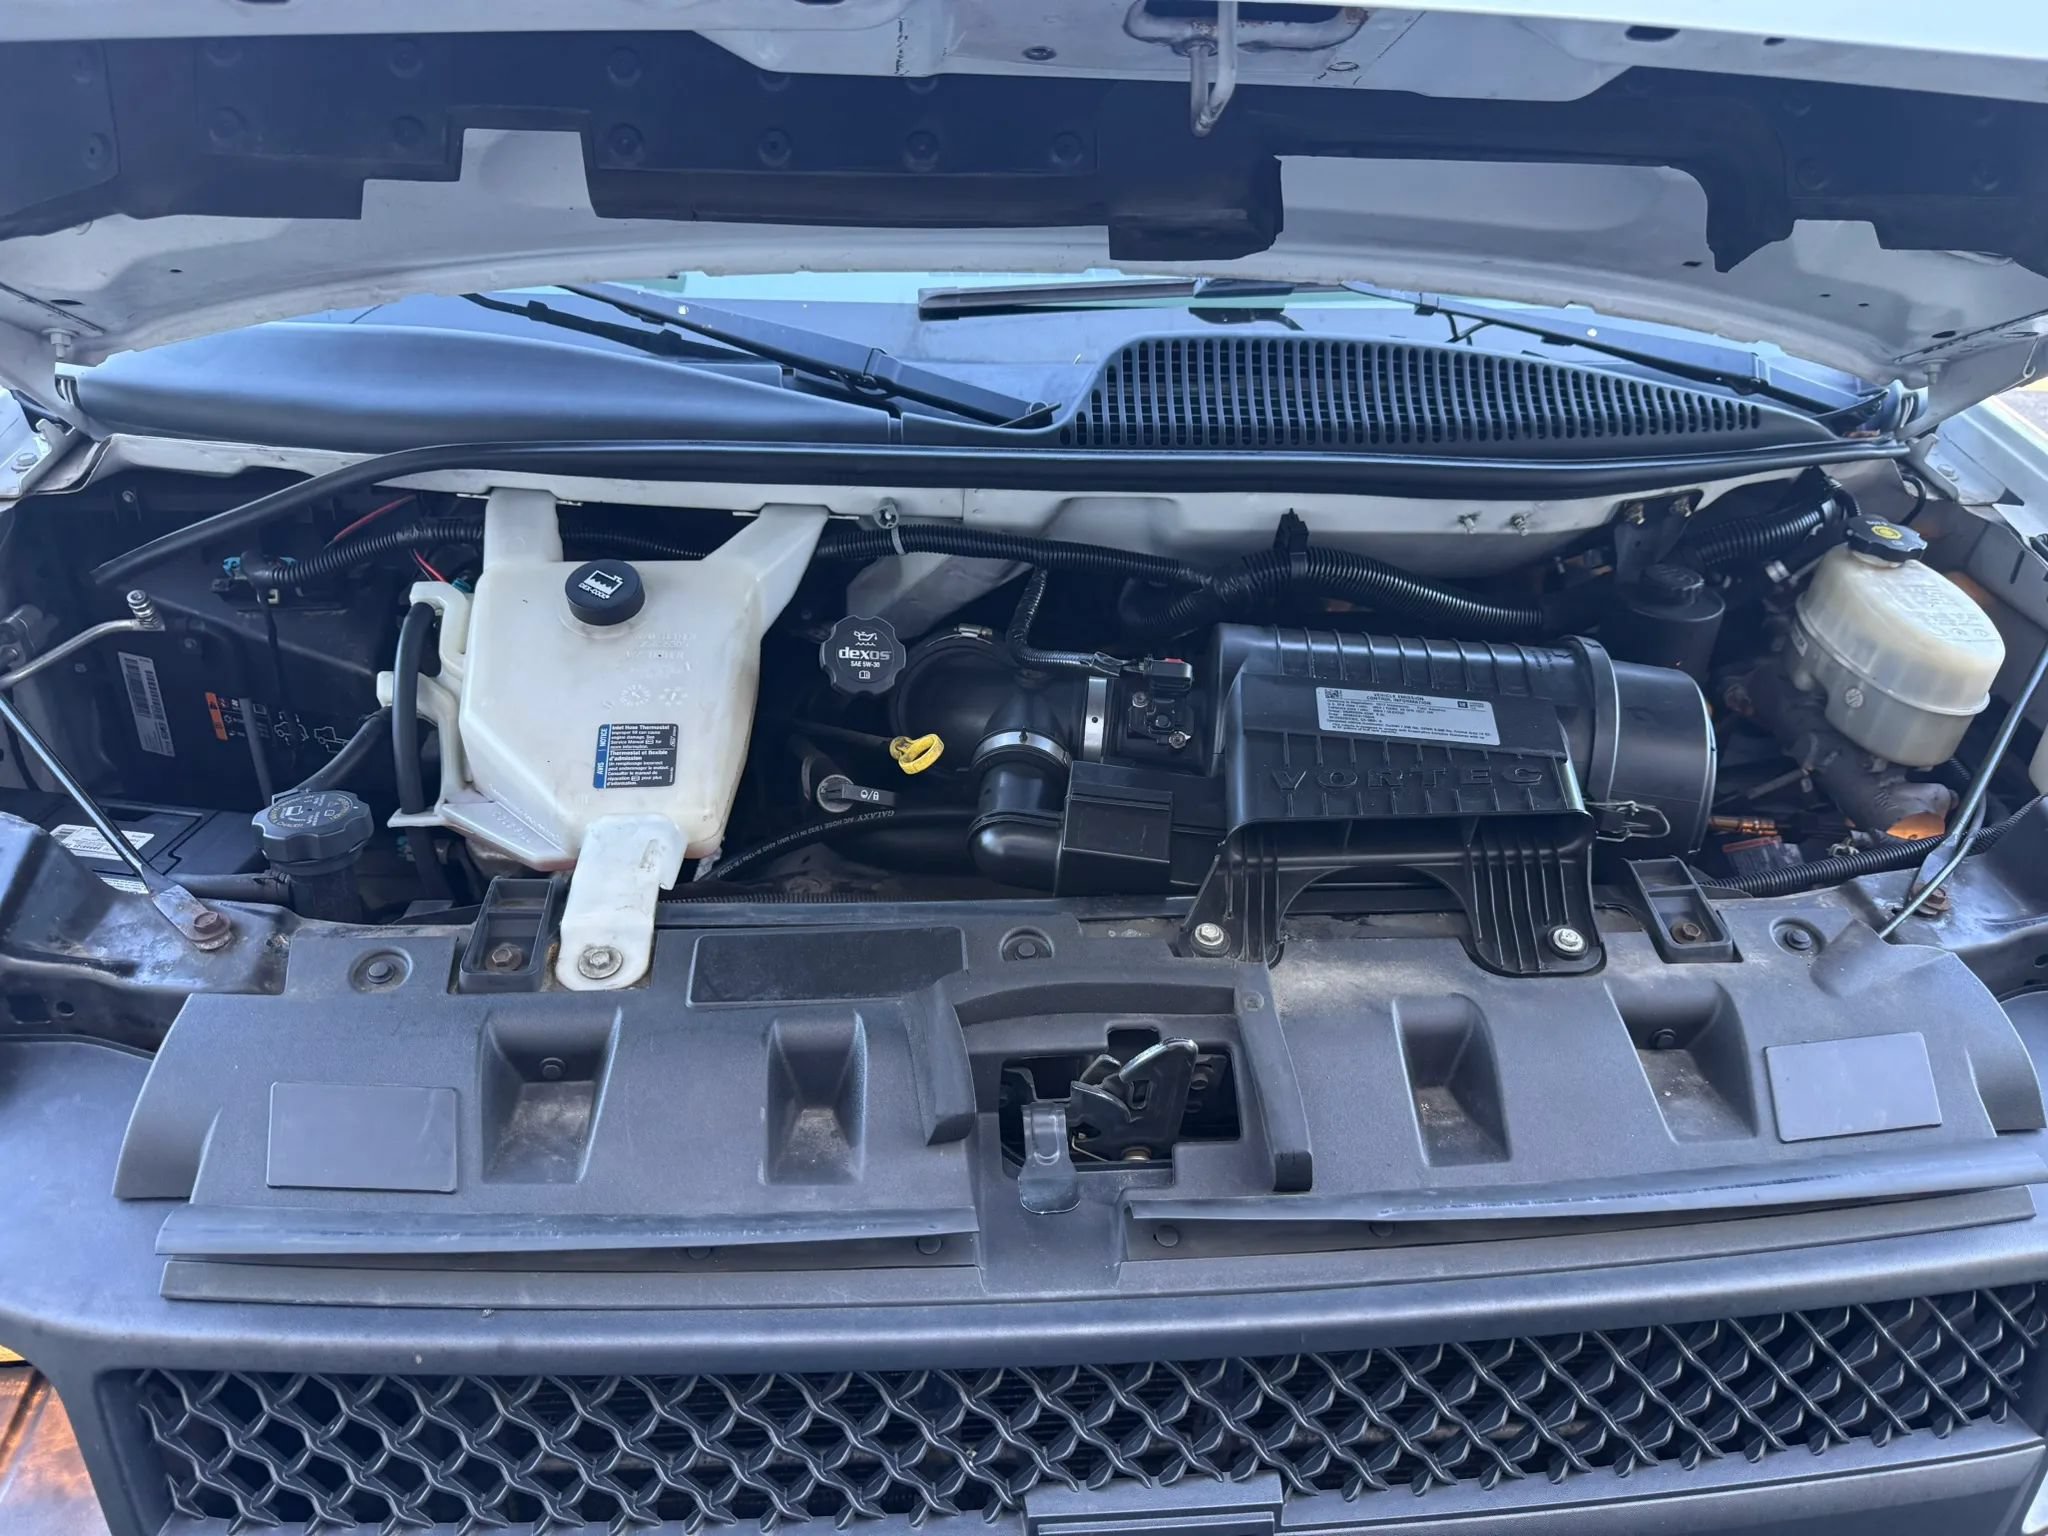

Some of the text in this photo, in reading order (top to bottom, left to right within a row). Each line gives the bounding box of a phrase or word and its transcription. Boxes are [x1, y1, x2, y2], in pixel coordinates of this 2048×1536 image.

[838, 646, 892, 661] dexos
[600, 728, 608, 747] NOTICE
[1270, 764, 1544, 791] VORTEC
[857, 809, 895, 822] GALAXY
